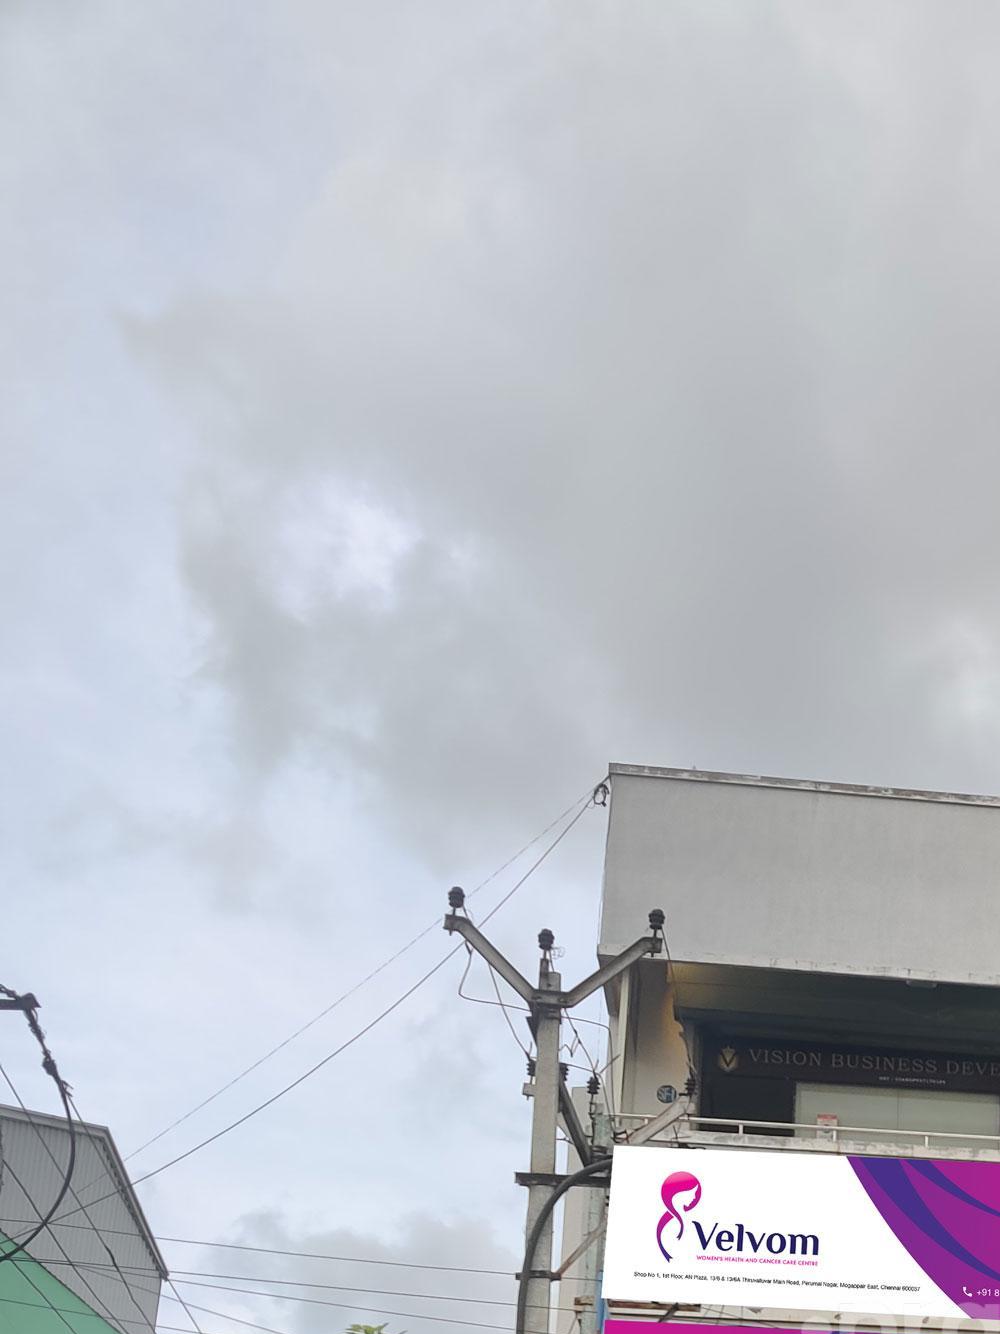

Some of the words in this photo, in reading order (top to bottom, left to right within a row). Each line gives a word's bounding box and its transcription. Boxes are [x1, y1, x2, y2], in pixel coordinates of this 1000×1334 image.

[750, 1049, 821, 1067] VISION
[832, 1053, 938, 1073] BUSINESS
[692, 1221, 819, 1255] Velvom
[634, 1271, 647, 1279] Shop
[976, 1289, 991, 1297] +91
